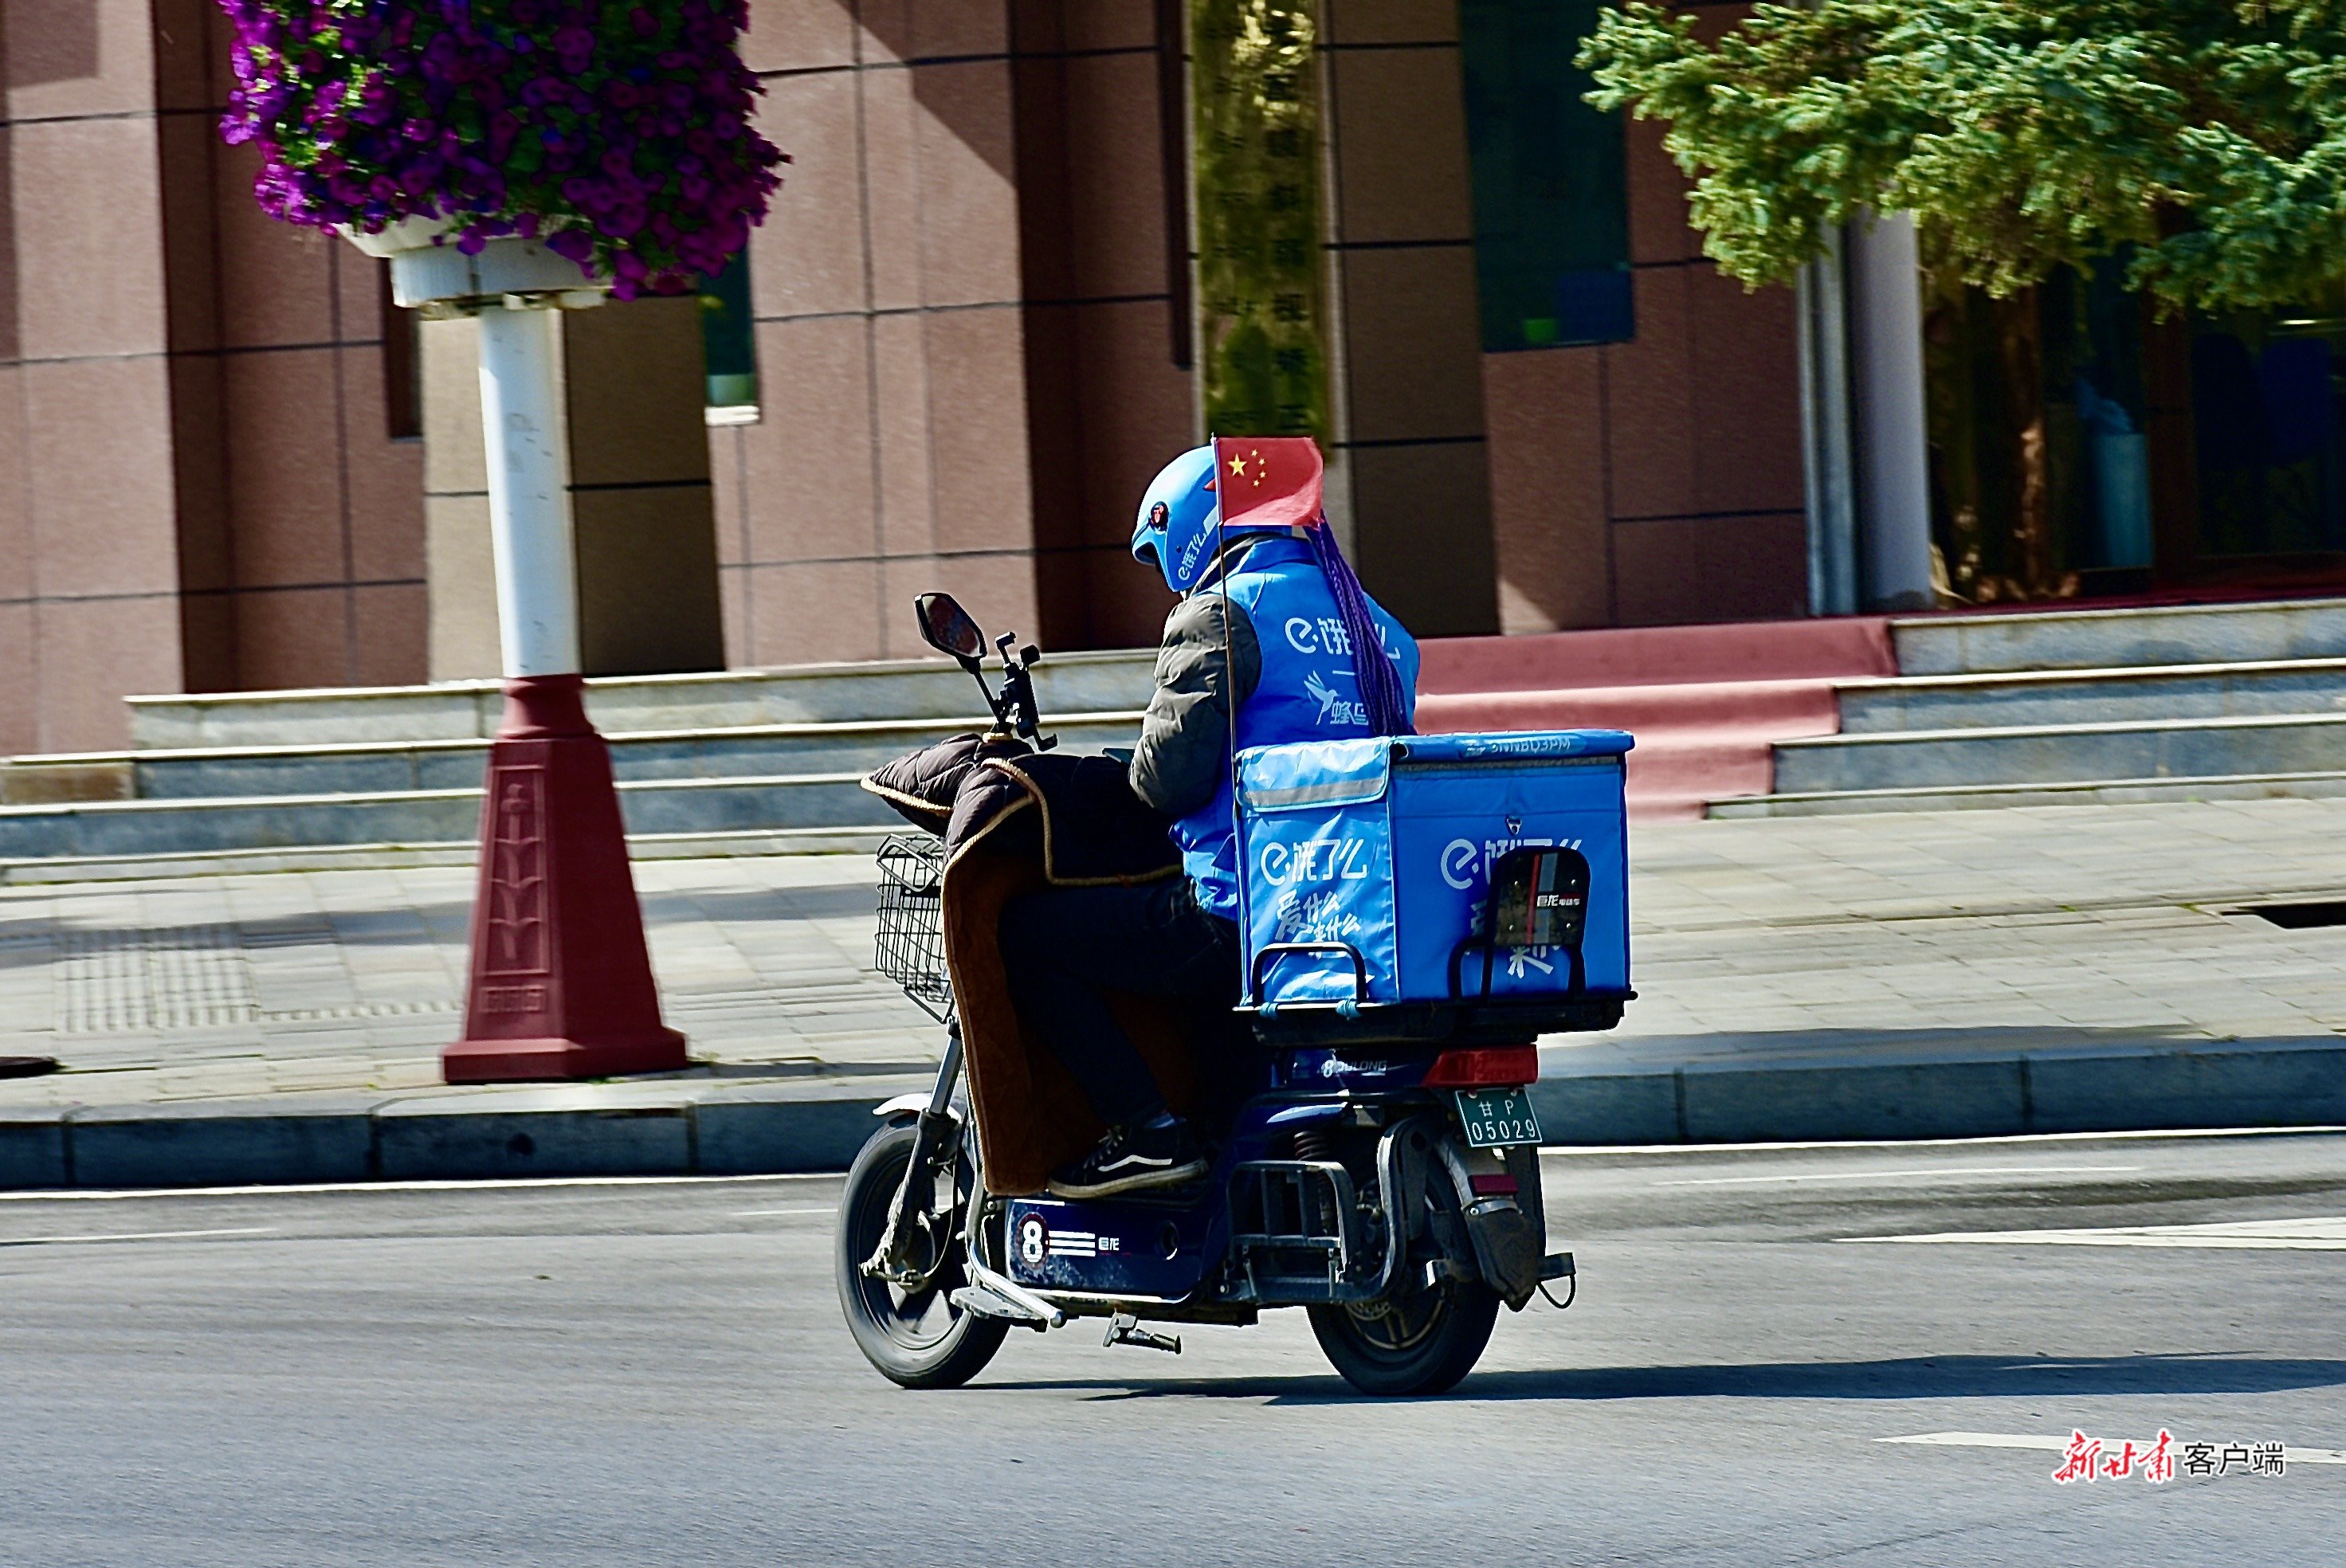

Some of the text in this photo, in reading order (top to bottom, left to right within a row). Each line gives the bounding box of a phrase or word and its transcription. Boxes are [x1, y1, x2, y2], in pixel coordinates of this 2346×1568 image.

[1504, 1100, 1514, 1115] P
[1472, 1119, 1536, 1141] 05029
[1022, 1220, 1043, 1263] 8
